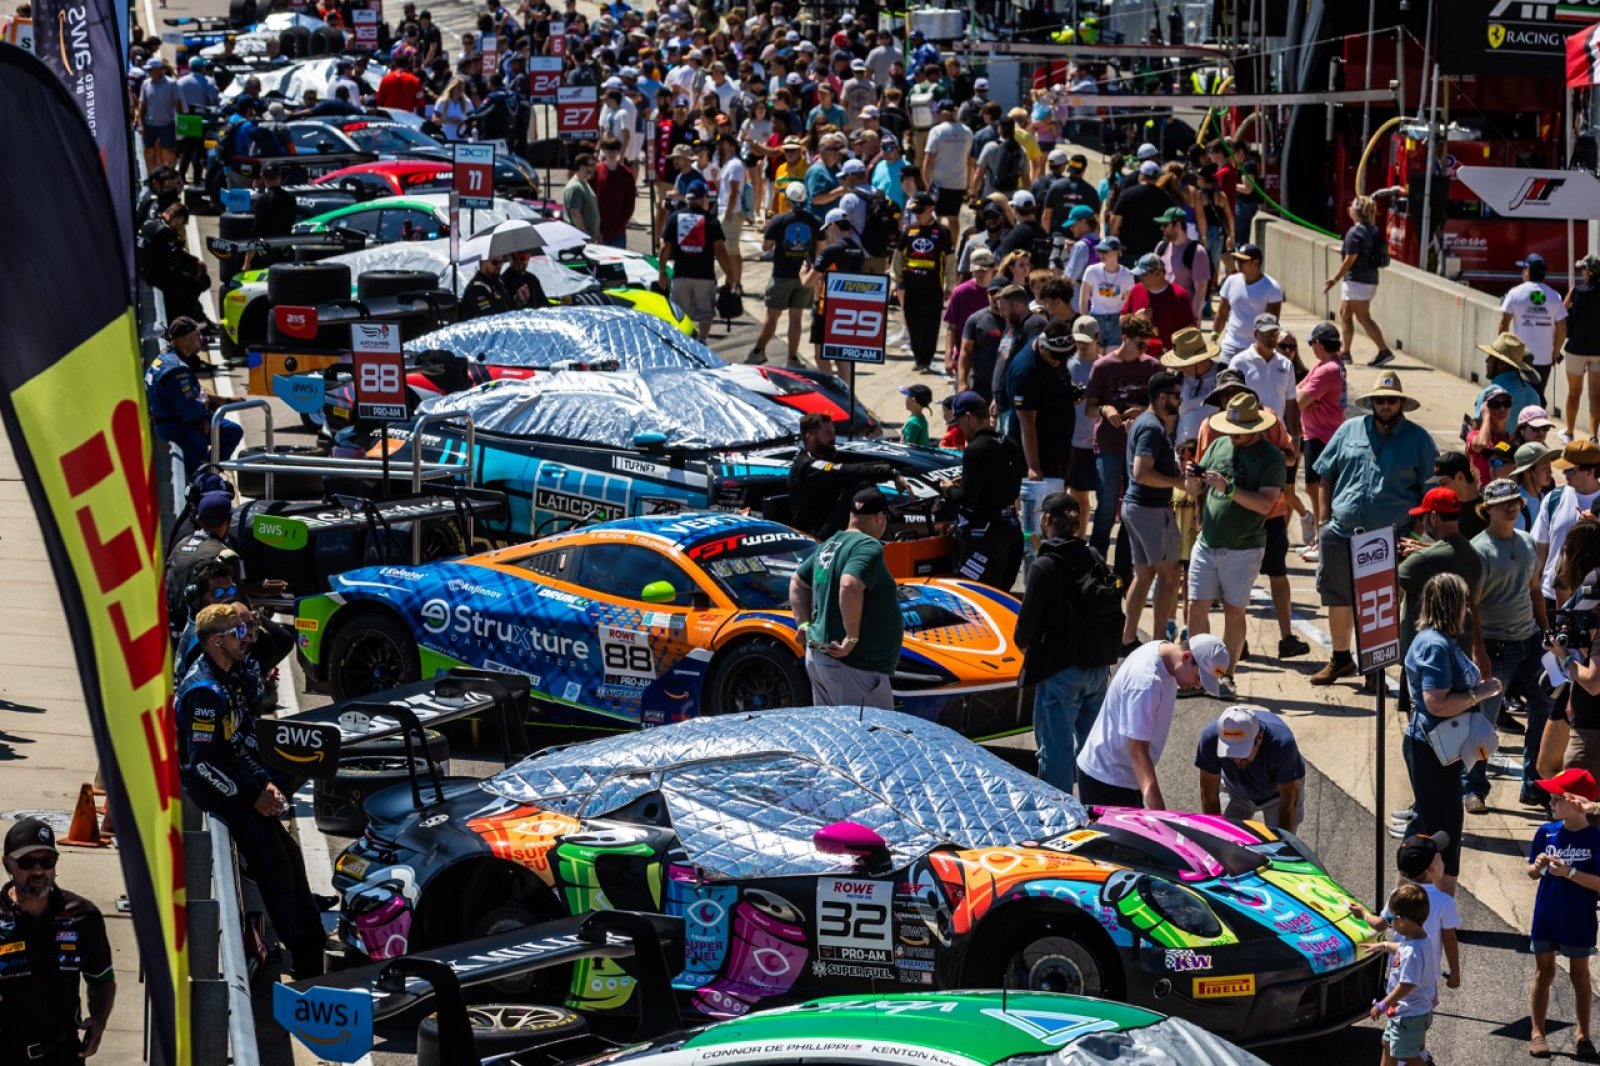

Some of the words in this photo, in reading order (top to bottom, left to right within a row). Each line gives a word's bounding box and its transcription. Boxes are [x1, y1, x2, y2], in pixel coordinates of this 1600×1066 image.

[1506, 30, 1560, 46] RACING
[534, 76, 560, 91] 24
[563, 108, 595, 126] 27
[286, 313, 306, 323] aws
[831, 308, 882, 338] 29
[842, 347, 877, 360] PRO-AM
[361, 363, 400, 393] 88
[292, 380, 314, 393] aws
[373, 406, 401, 417] PRO-AM
[258, 522, 282, 535] aws
[1361, 585, 1395, 633] 32
[608, 628, 637, 641] ROWE
[604, 642, 653, 673] 88
[1372, 646, 1397, 665] PRO-AM
[194, 707, 216, 718] aws
[275, 725, 323, 749] aws
[1545, 842, 1592, 866] Dodgers
[833, 881, 875, 895] ROWE
[820, 900, 887, 941] 32
[840, 947, 886, 961] PRO-AM
[1174, 953, 1213, 971] KW
[1198, 979, 1251, 996] PIRELLI
[294, 998, 350, 1026] aws
[702, 1045, 762, 1060] CONNOR
[764, 1044, 784, 1053] DE
[871, 1045, 927, 1060] KENTON
